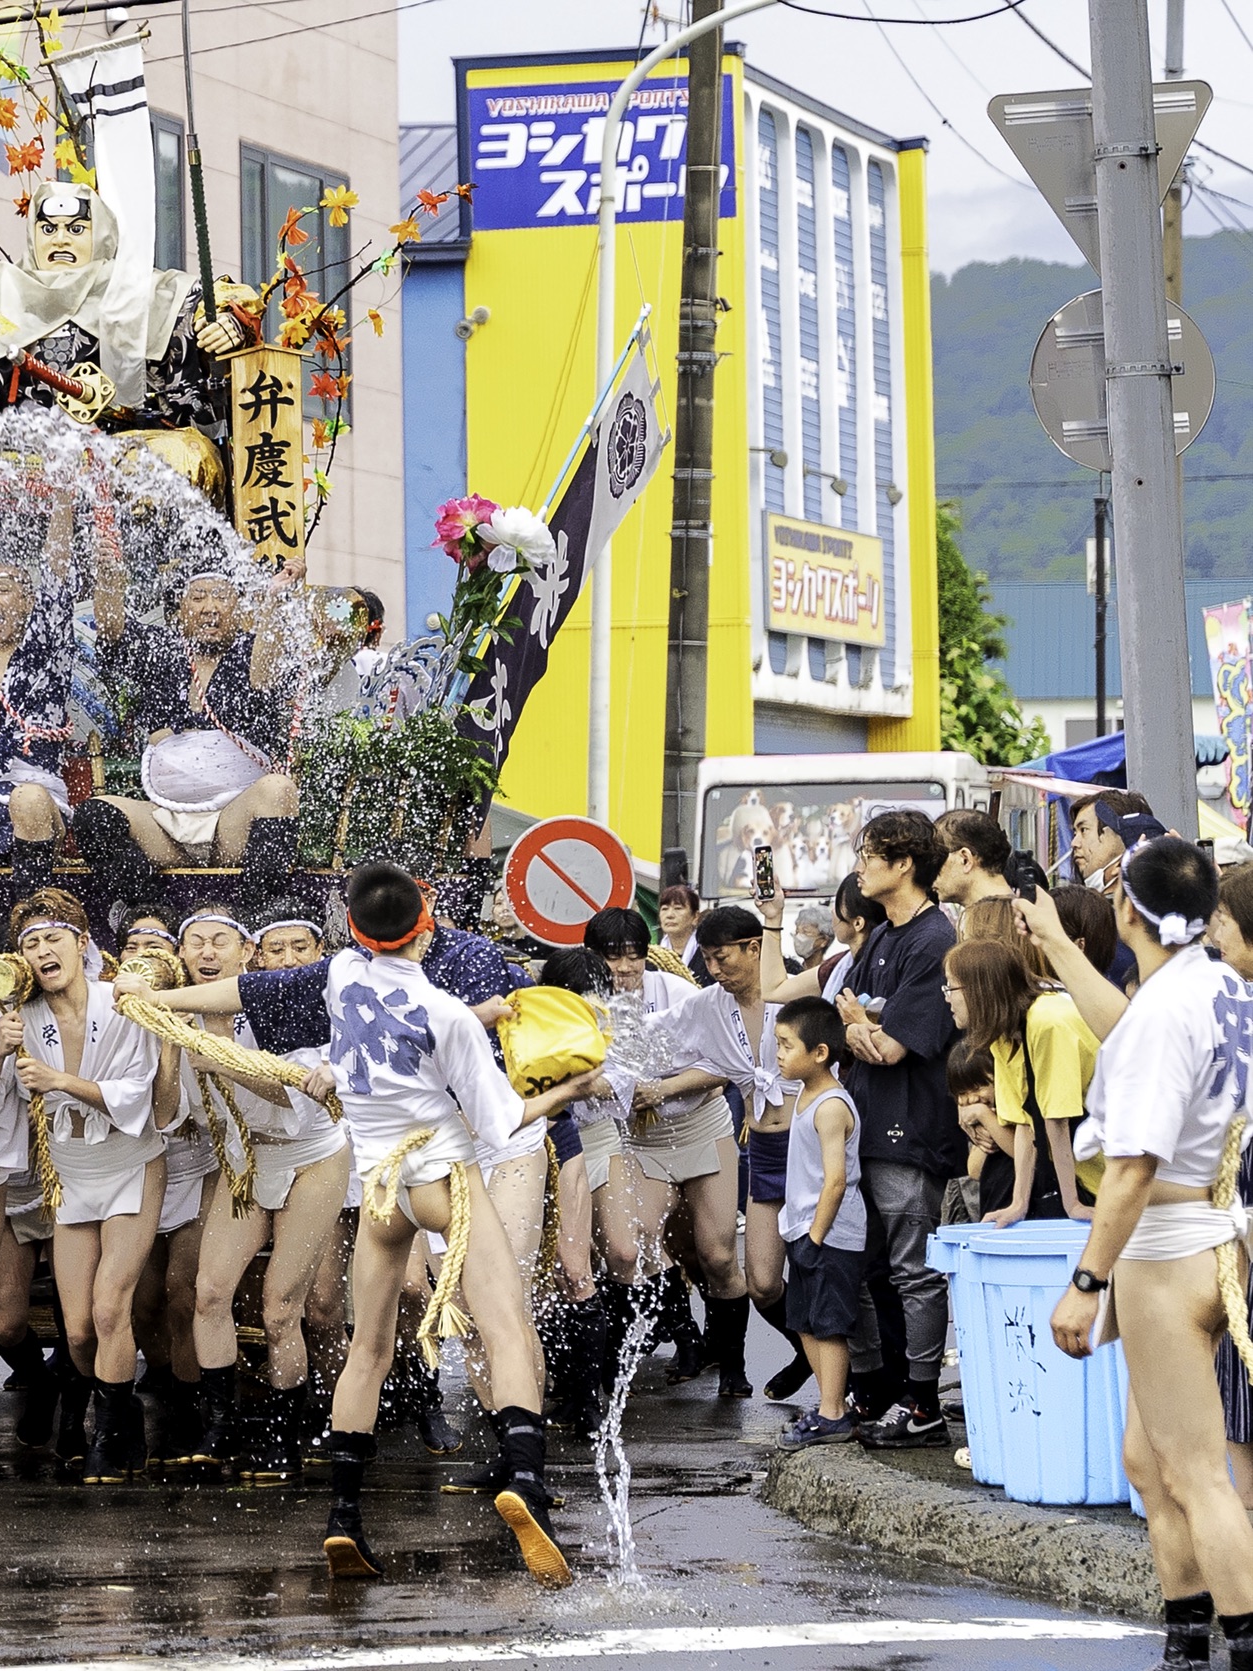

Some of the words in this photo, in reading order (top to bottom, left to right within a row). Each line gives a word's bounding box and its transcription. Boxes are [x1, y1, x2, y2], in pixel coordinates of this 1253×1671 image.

[486, 93, 610, 118] YOSHIKAWA
[613, 88, 689, 112] PORTS
[239, 369, 298, 573] 弁慶武
[772, 556, 880, 629] ヨシカワスポーツ
[42, 1024, 59, 1048] 栄
